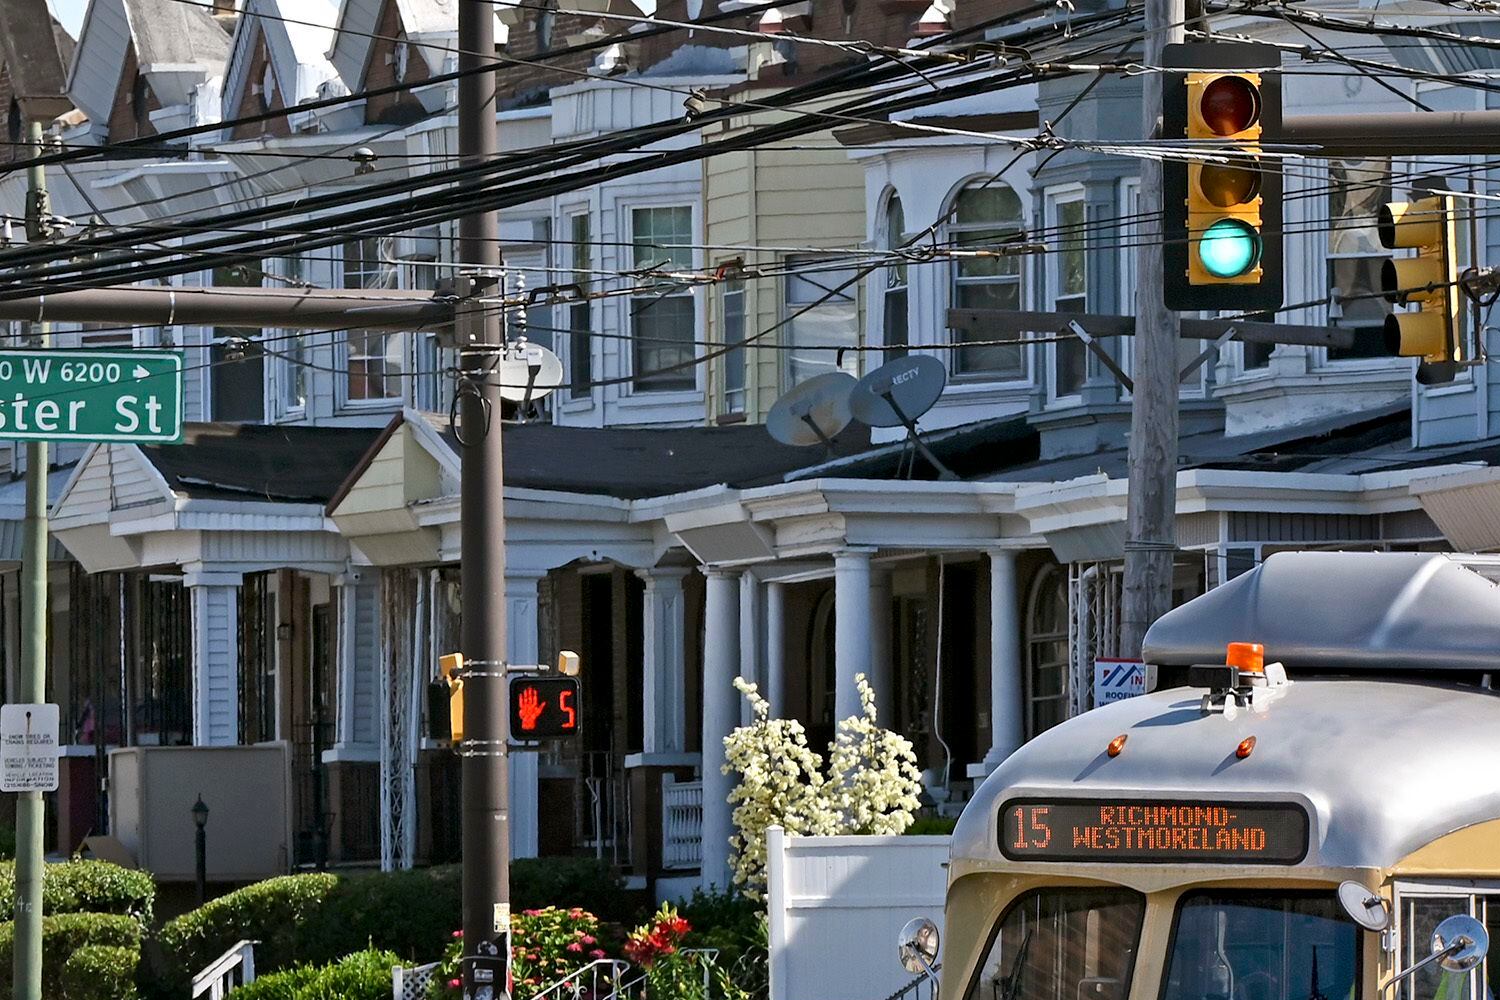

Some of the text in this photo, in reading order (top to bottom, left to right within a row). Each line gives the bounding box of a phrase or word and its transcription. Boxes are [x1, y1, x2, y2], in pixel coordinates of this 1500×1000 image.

[23, 359, 51, 384] W
[61, 362, 121, 383] 6200
[115, 395, 162, 433] St
[560, 690, 575, 729] 5
[1013, 807, 1051, 849] 15
[1100, 805, 1237, 827] RICHMOND-
[1072, 826, 1266, 851] WESTMORELAND
